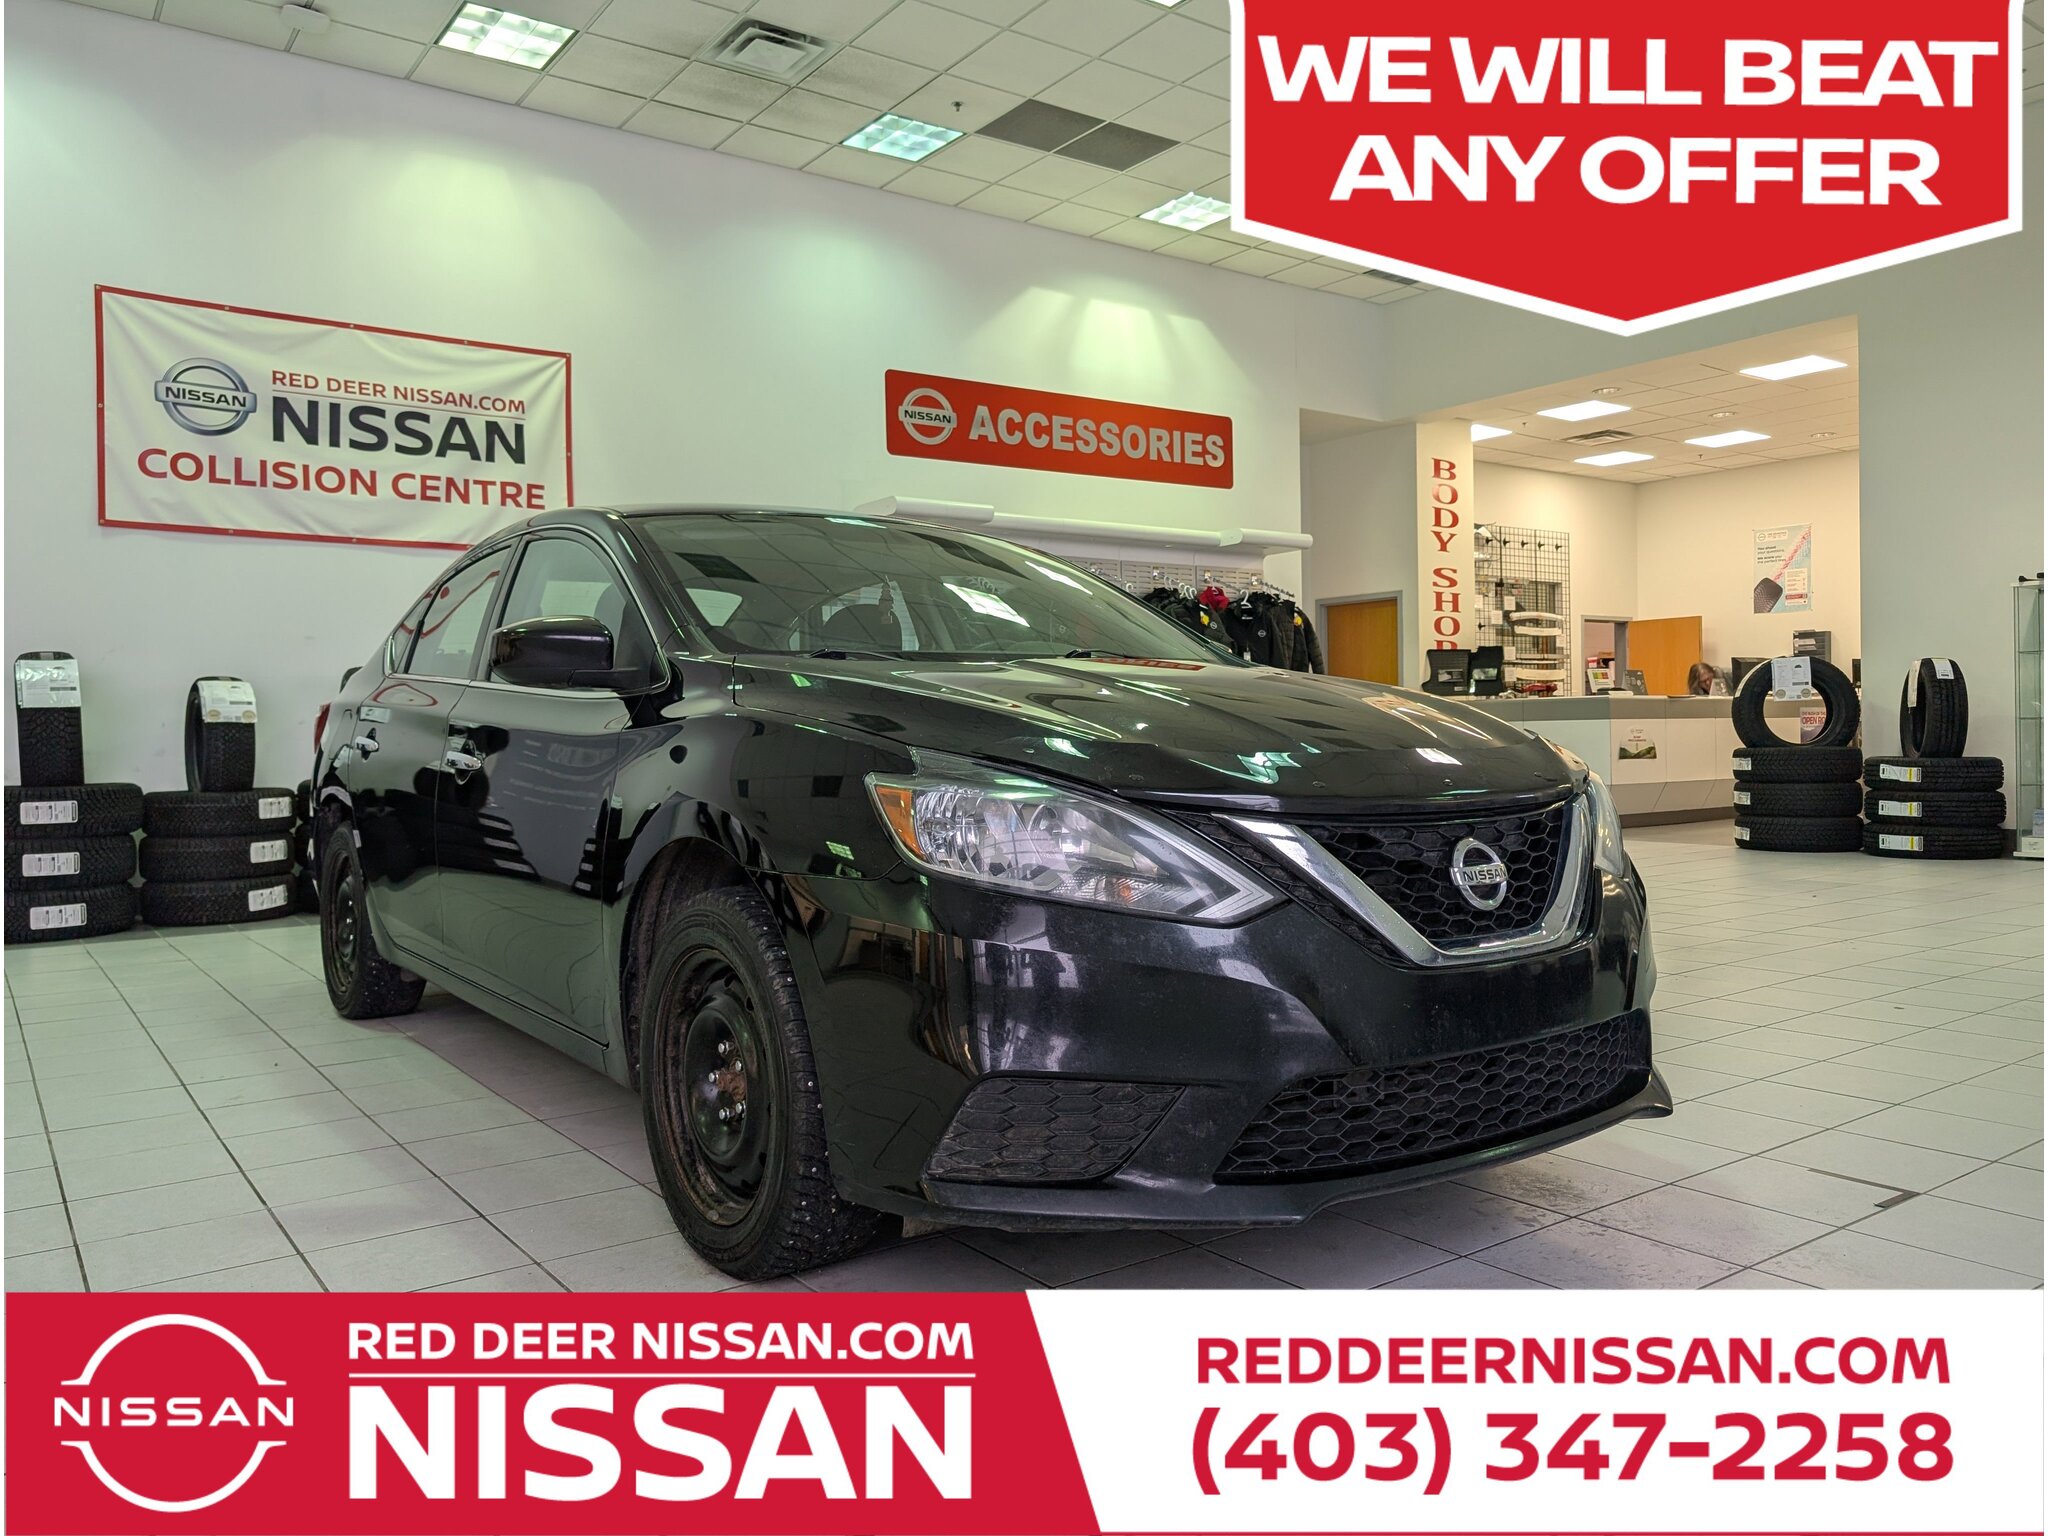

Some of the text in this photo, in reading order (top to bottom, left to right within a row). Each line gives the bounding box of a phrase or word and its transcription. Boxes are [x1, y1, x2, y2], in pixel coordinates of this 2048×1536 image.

[165, 386, 247, 408] NISSAN
[272, 370, 526, 415] RED DEER NISSAN.COM
[904, 409, 952, 424] NISSAN
[272, 396, 526, 465] NISSAN
[968, 404, 1226, 468] ACCESSORIES
[137, 448, 546, 510] COLLISION CENTRE
[1431, 457, 1460, 553] BODY
[1463, 867, 1507, 882] NISSAN
